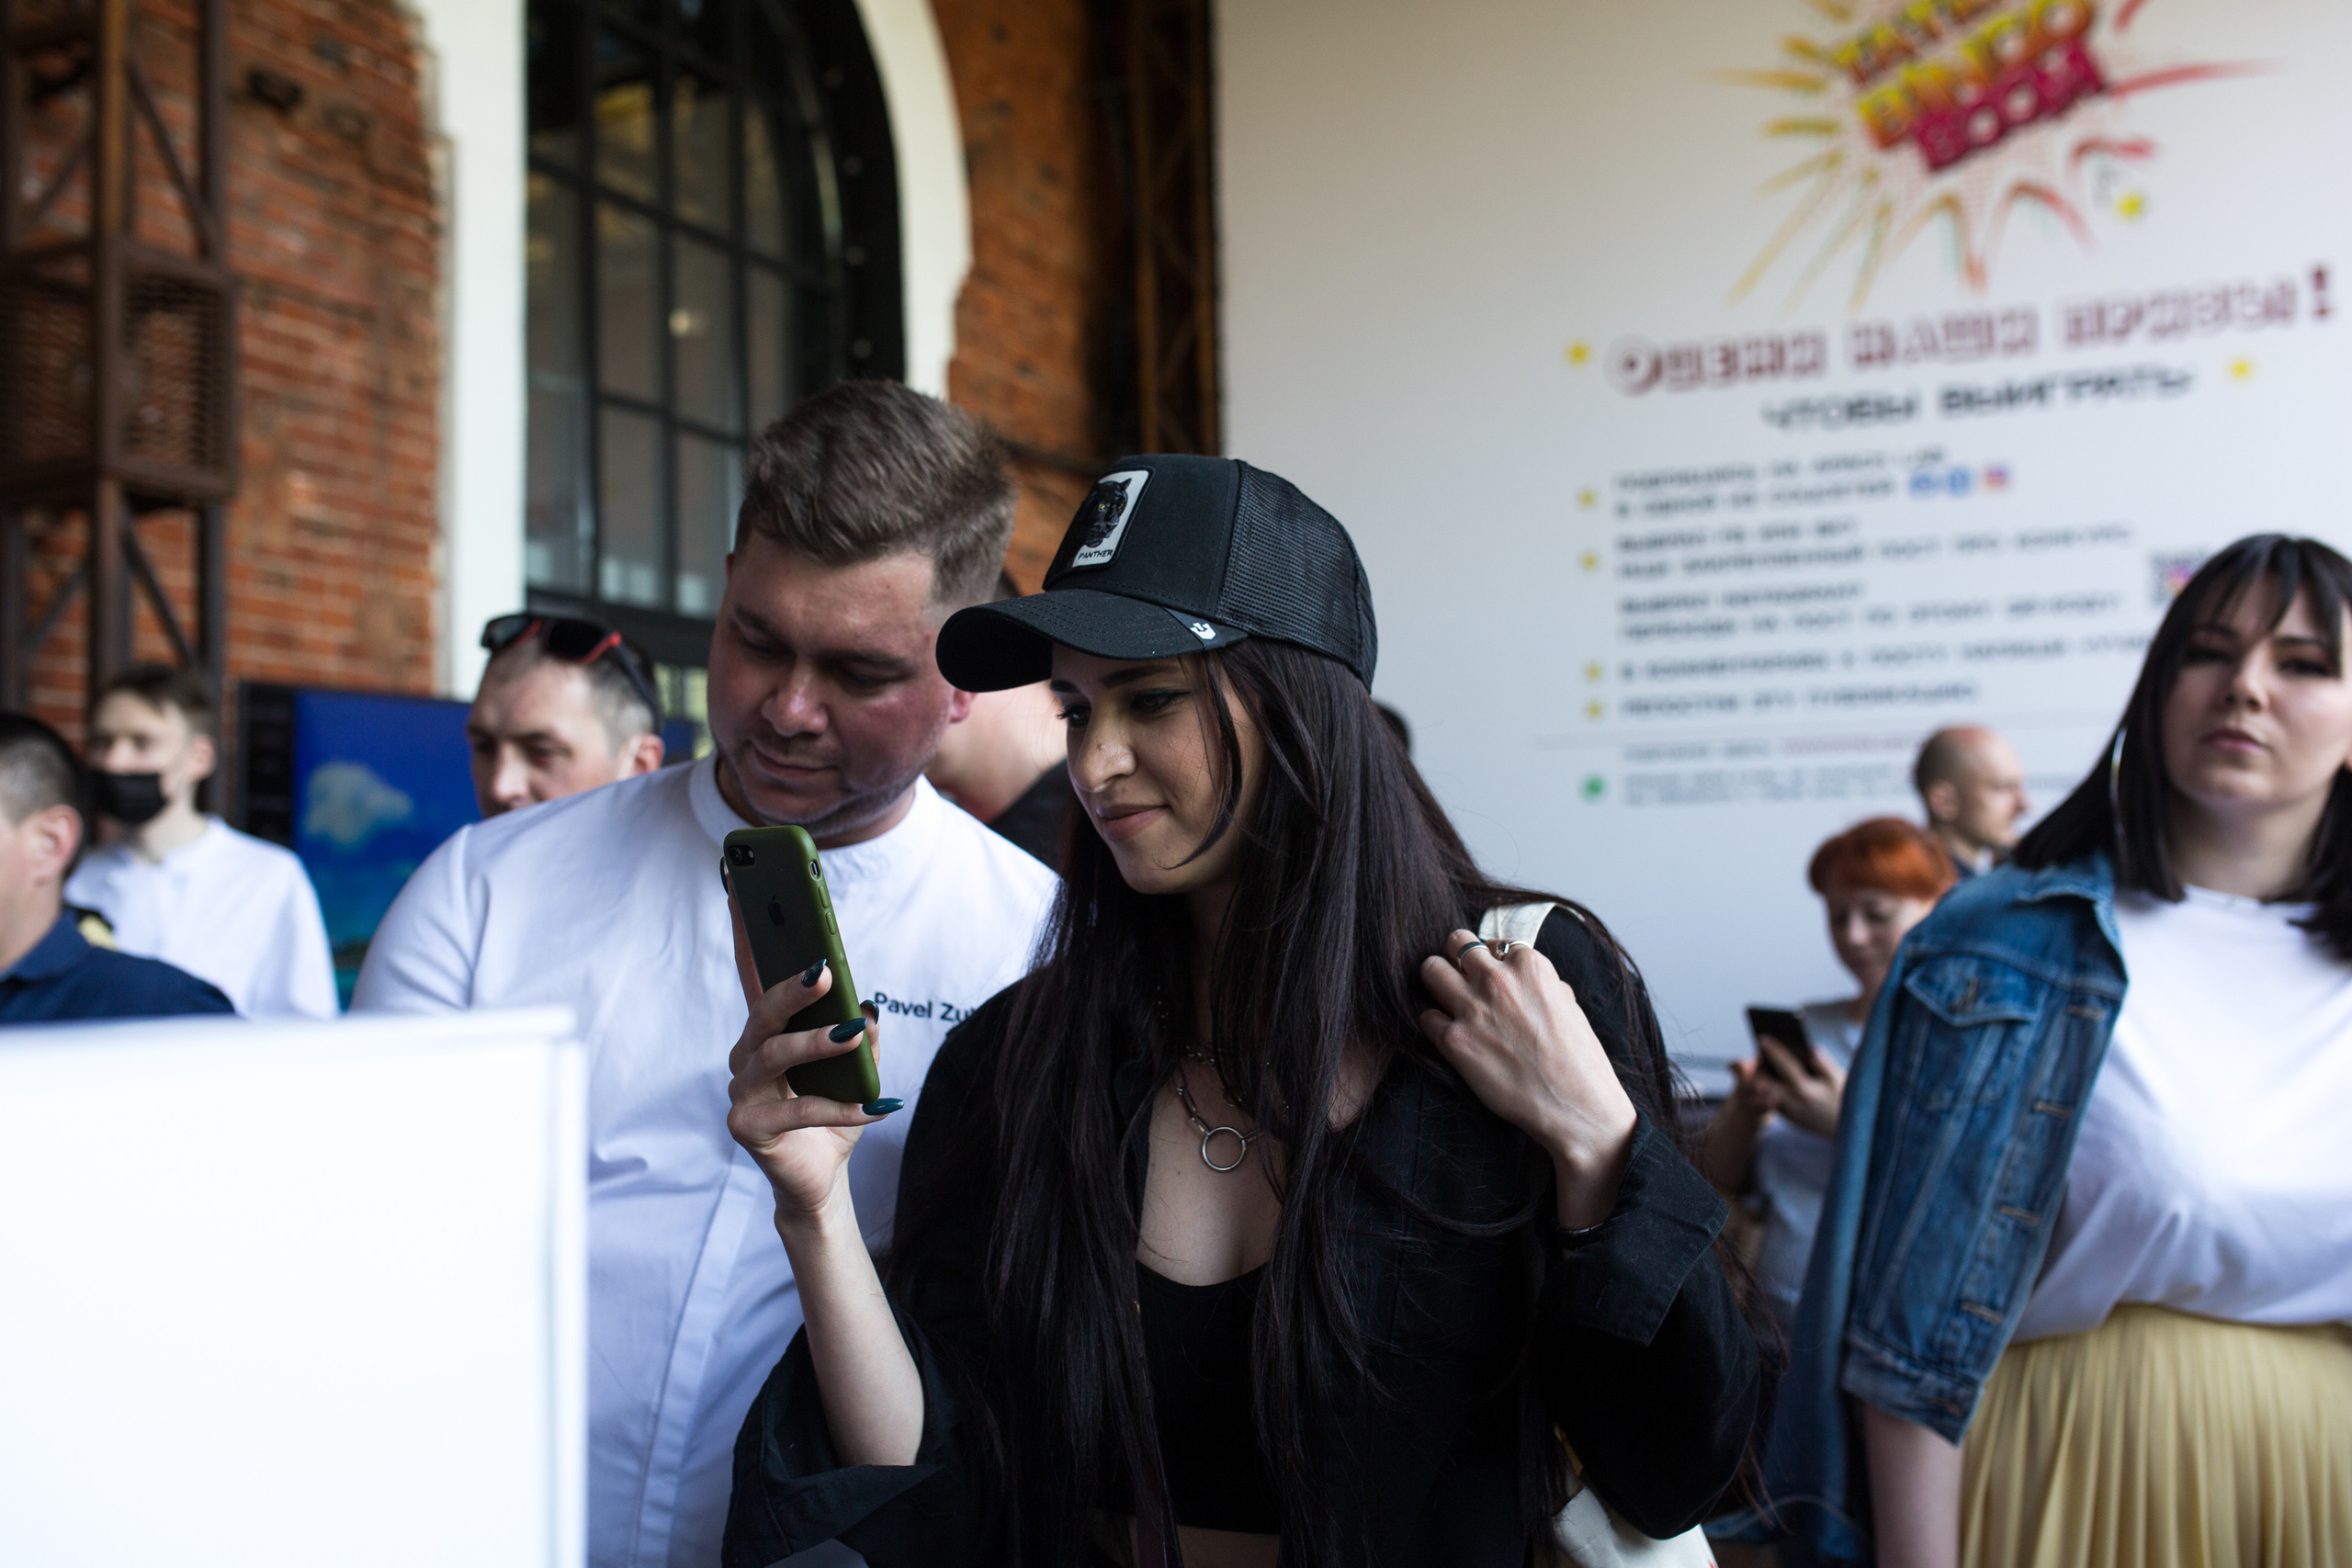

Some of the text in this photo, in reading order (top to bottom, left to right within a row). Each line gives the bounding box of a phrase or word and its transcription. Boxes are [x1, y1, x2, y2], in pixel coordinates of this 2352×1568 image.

[1078, 549, 1114, 560] PANTHER
[875, 990, 976, 1022] Pavel Zu
